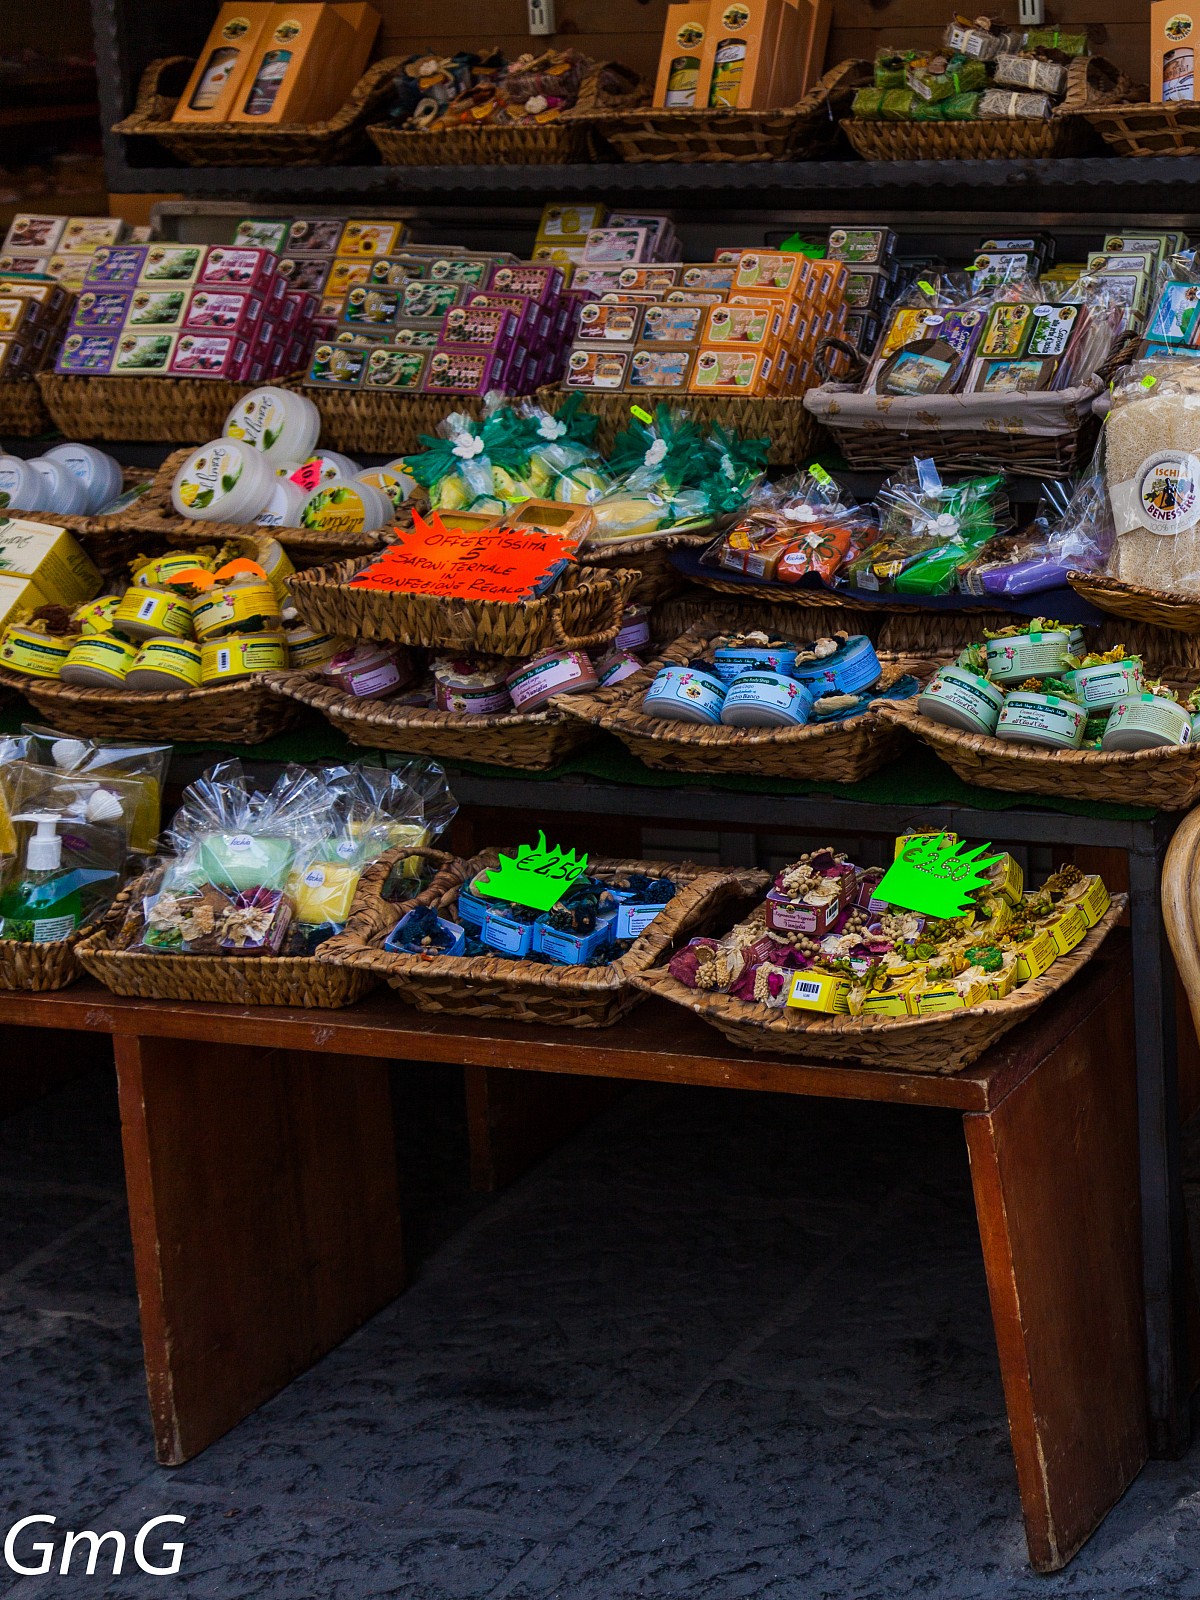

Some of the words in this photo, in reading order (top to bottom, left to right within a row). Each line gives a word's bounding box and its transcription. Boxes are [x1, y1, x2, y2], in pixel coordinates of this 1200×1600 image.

[1054, 328, 1068, 352] Sapone
[1146, 494, 1197, 521] BENESSERE
[458, 547, 487, 561] 5
[441, 572, 457, 580] IN
[449, 562, 518, 577] TERMALE
[466, 578, 526, 594] REGALO
[903, 847, 924, 863] €
[516, 853, 542, 872] €
[534, 856, 585, 882] 2,50
